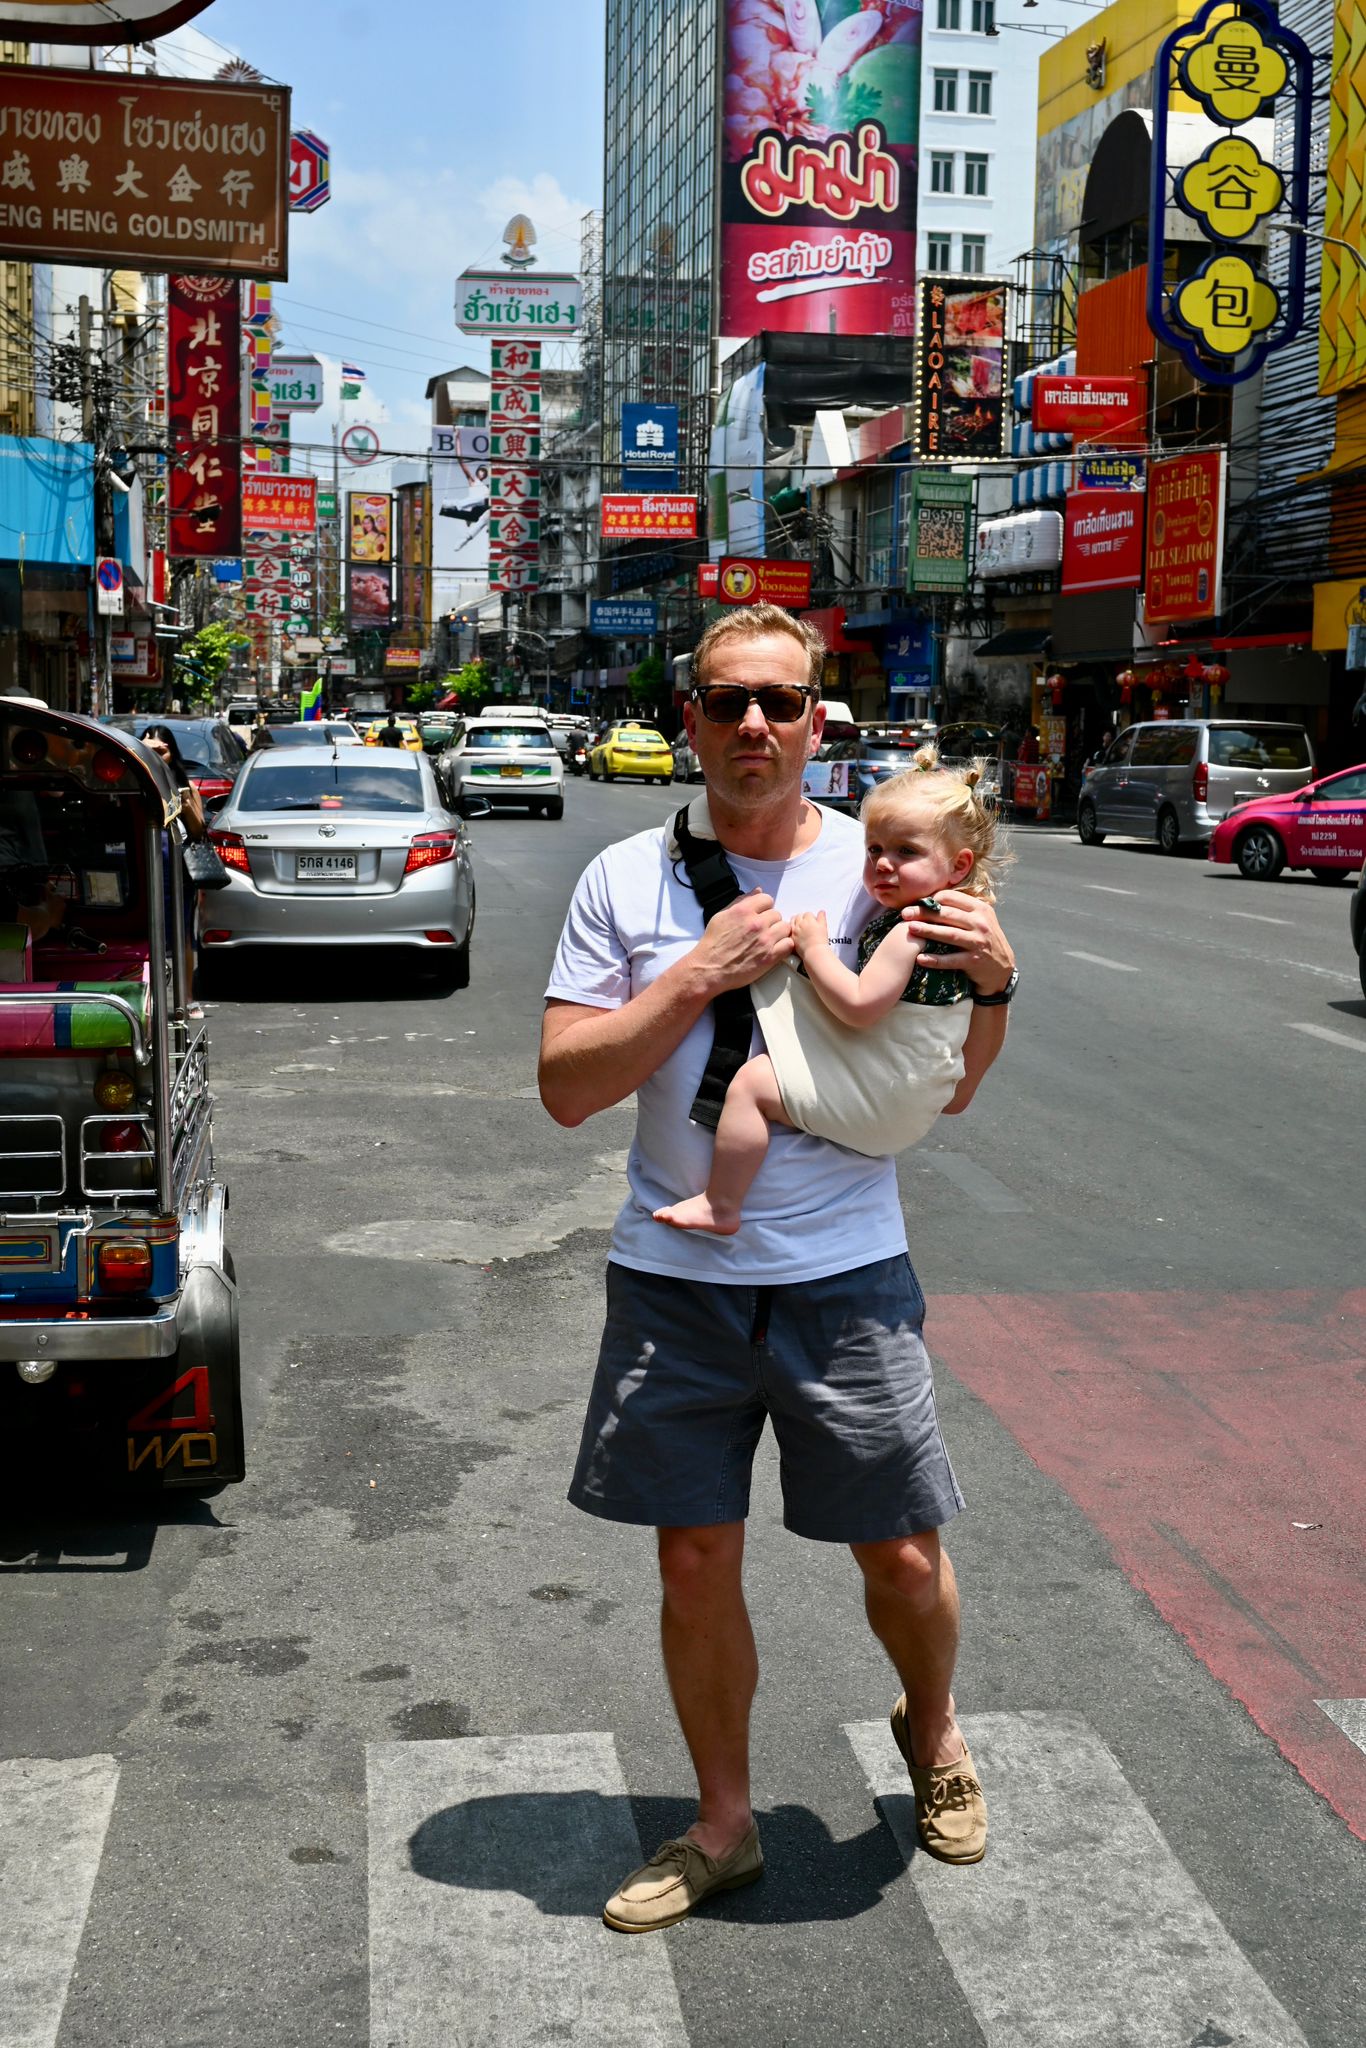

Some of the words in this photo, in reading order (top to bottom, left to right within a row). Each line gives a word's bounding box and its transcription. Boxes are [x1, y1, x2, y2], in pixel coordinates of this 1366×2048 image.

[53, 207, 118, 235] HENG
[128, 213, 265, 246] GOLDSMITH
[749, 234, 890, 277] รสต้มยำกุ้ง
[625, 450, 649, 459] Hotel
[650, 450, 676, 460] Royal
[300, 857, 323, 869] 5กส
[326, 857, 354, 869] 4146
